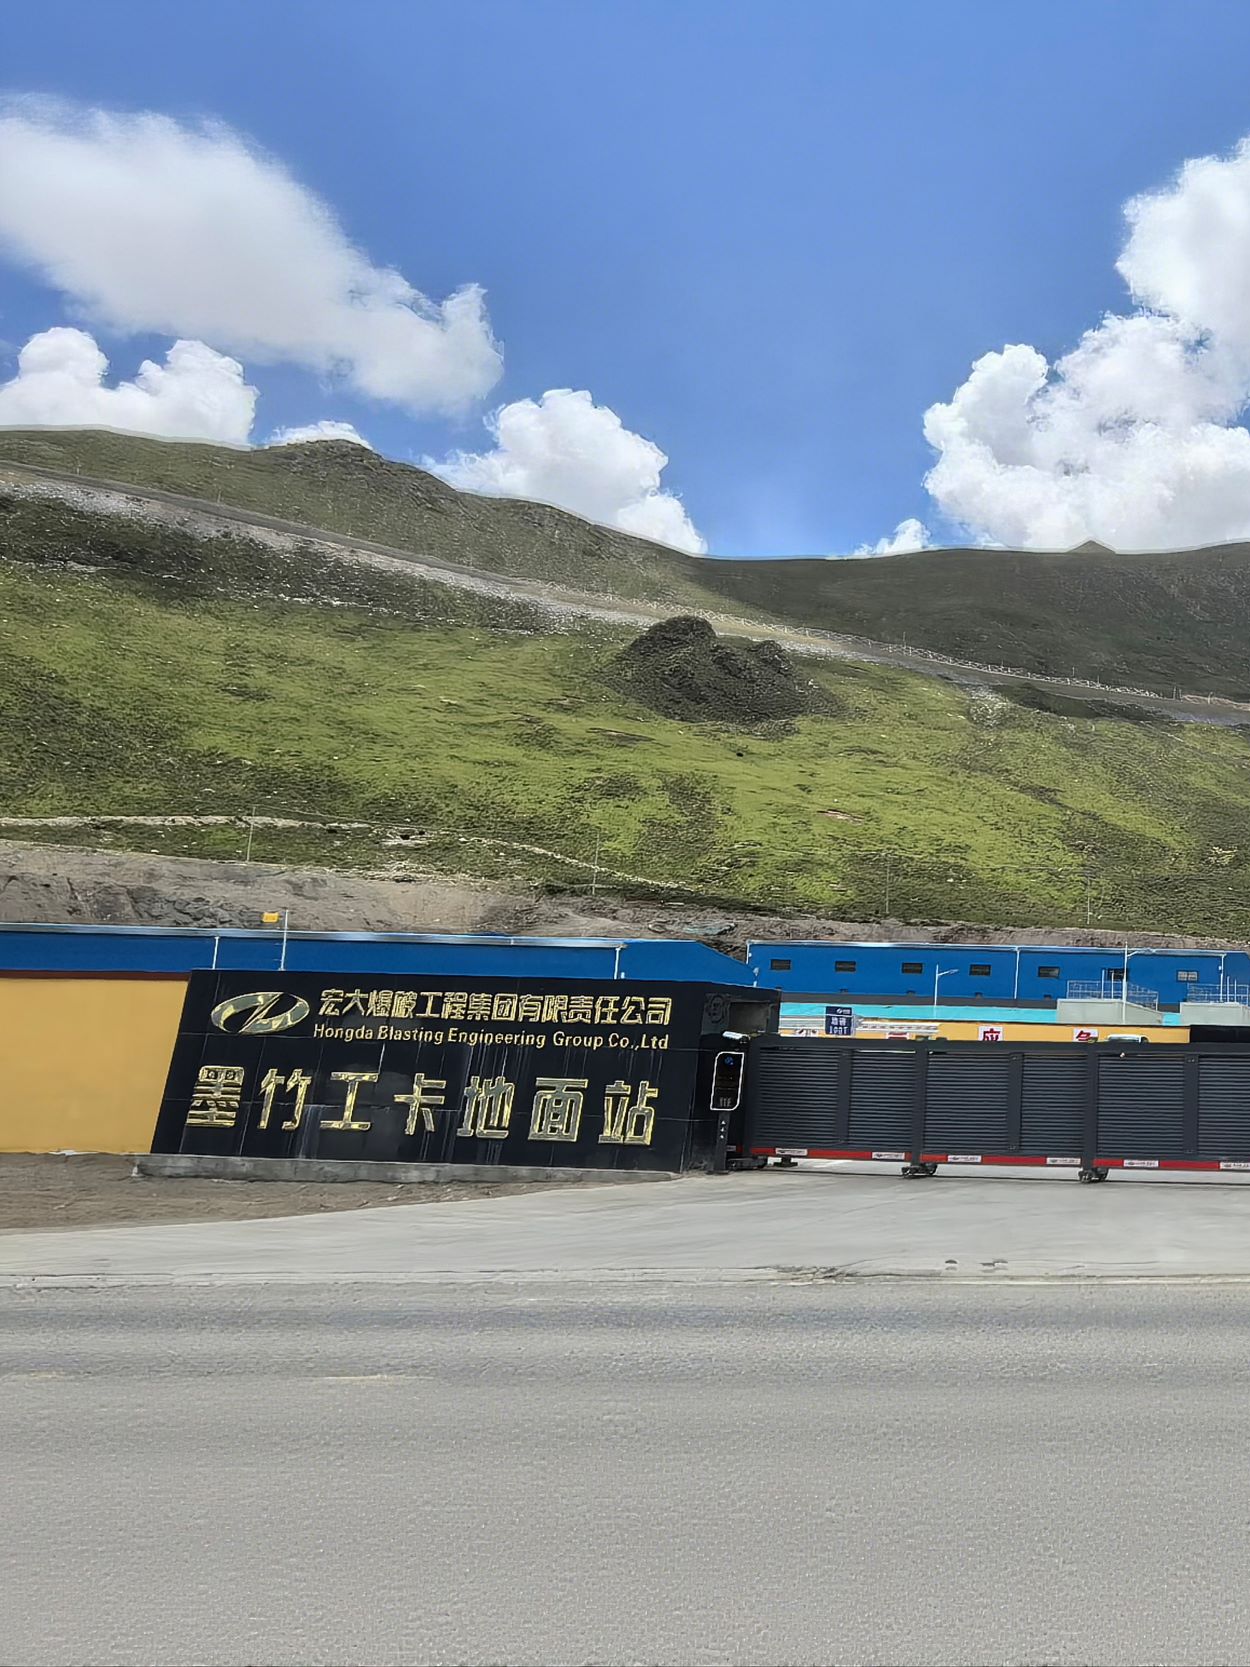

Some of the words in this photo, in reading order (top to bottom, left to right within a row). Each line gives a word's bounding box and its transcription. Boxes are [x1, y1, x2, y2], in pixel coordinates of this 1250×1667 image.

[318, 989, 673, 1026] 宏大爆破工程集团有限责任公司
[313, 1023, 374, 1043] Hongda
[376, 1025, 445, 1046] Blasting
[447, 1027, 547, 1049] Engineering
[552, 1031, 604, 1051] Group
[607, 1032, 670, 1051] Co.,Ltd
[185, 1064, 659, 1146] 墨竹工卡地面站
